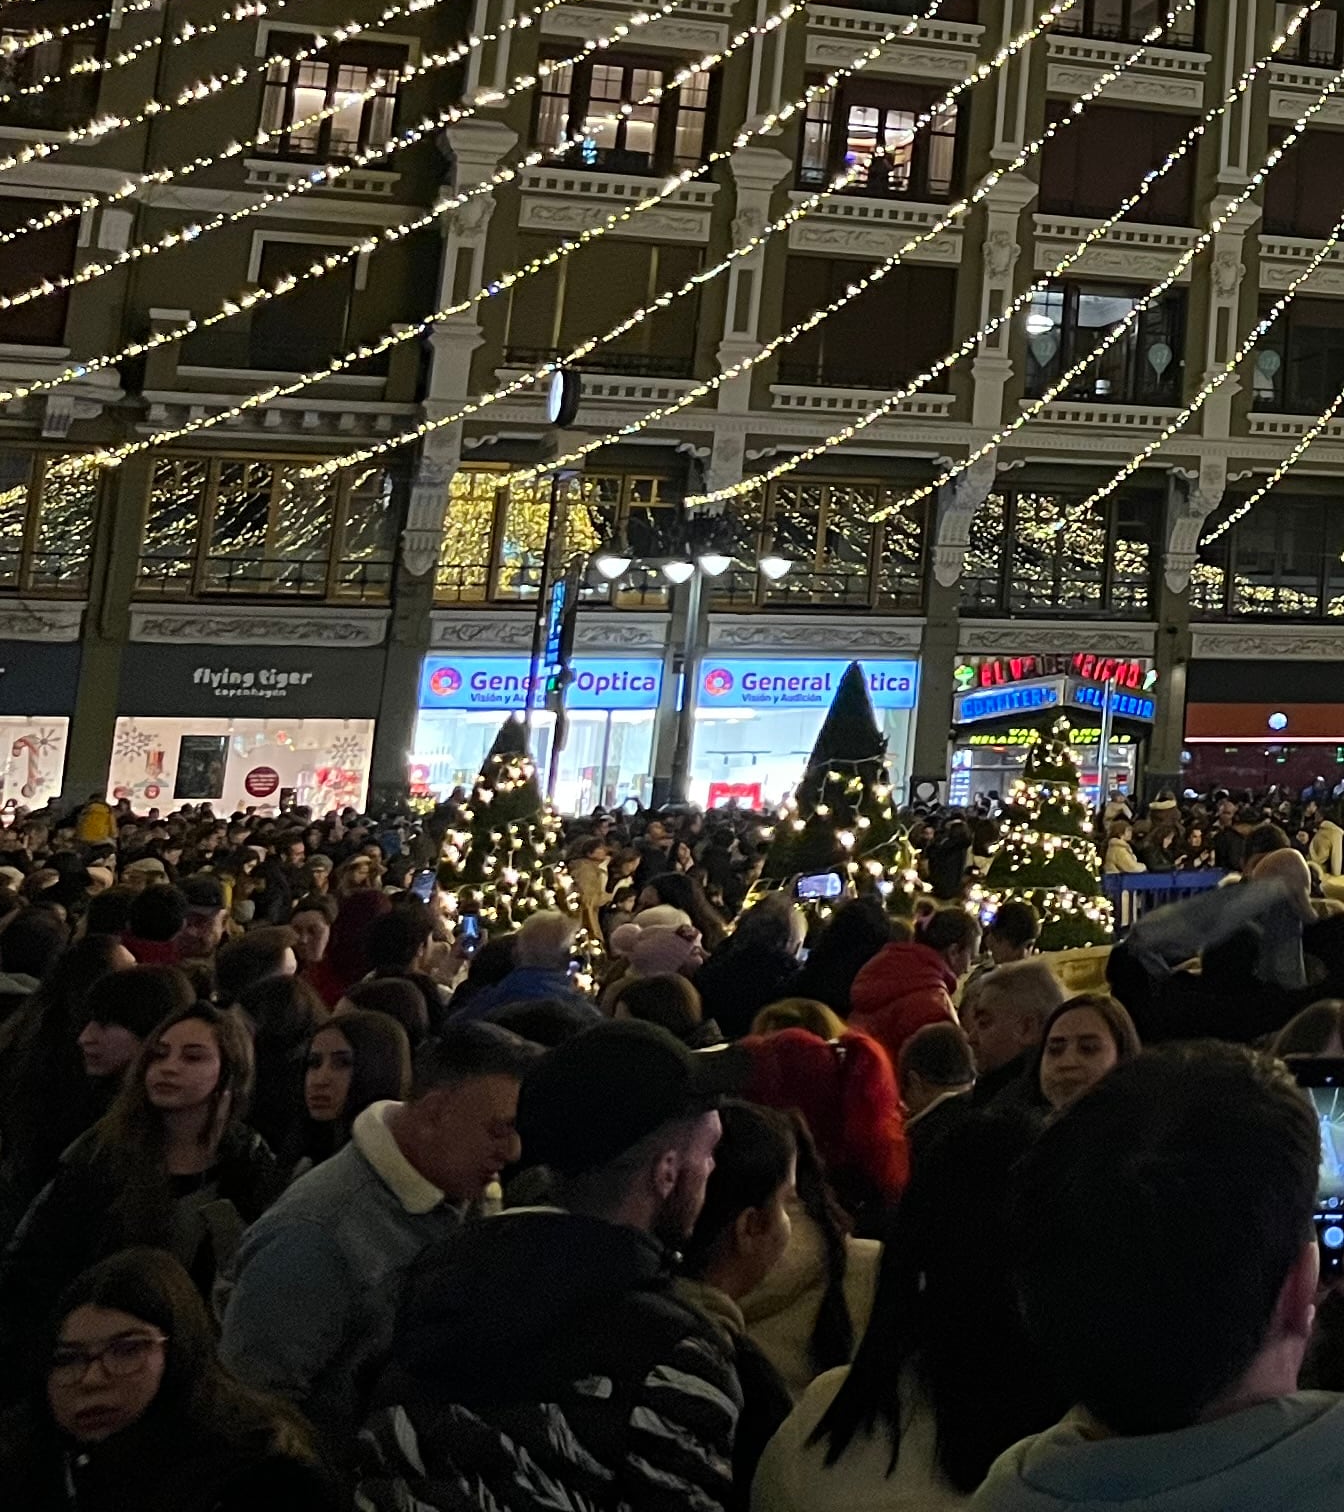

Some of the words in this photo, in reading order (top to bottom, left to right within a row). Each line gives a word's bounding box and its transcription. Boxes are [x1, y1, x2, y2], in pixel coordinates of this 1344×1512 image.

[193, 668, 254, 688] flying
[259, 669, 313, 688] tiger
[577, 672, 656, 695] Optica
[742, 673, 831, 691] General
[870, 674, 910, 692] tica
